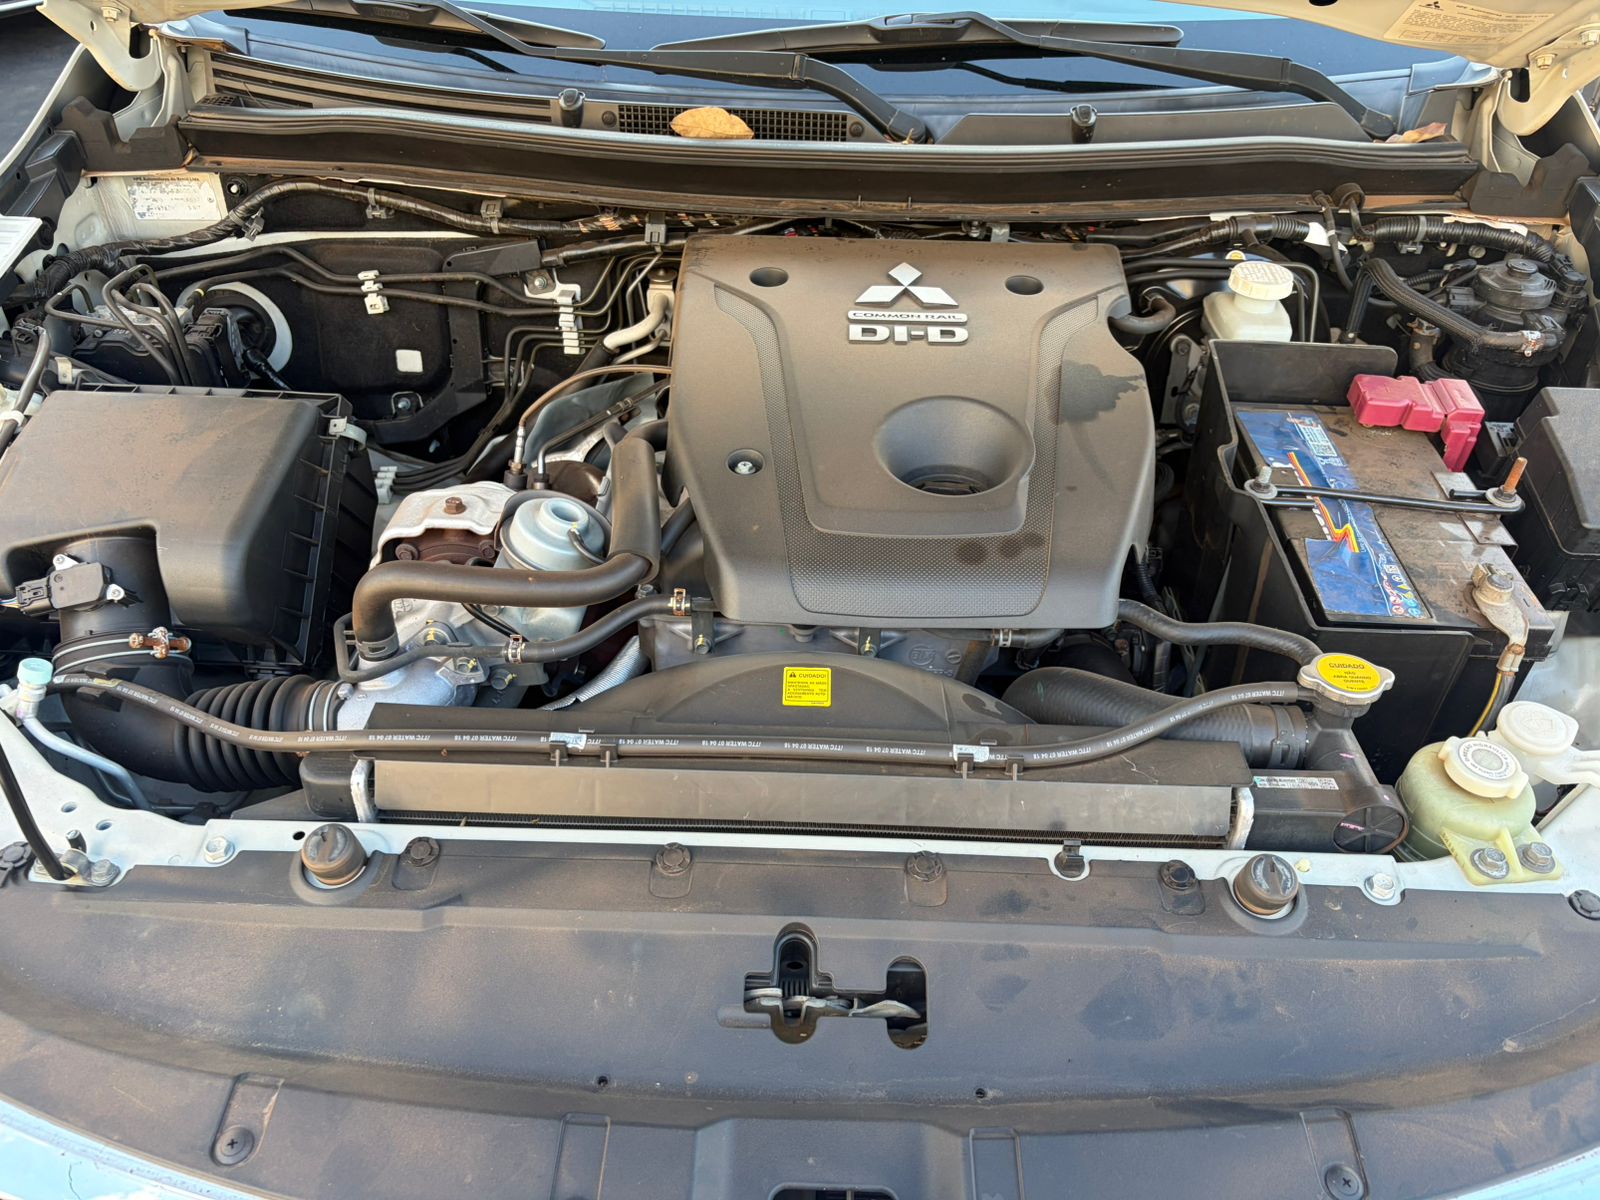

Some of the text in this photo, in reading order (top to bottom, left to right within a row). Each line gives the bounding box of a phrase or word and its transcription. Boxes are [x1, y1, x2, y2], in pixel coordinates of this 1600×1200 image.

[852, 312, 920, 320] COMMON
[848, 324, 969, 344] DI-D
[1252, 690, 1271, 698] WATER
[1126, 730, 1143, 742] WATER
[1057, 749, 1078, 758] WATER
